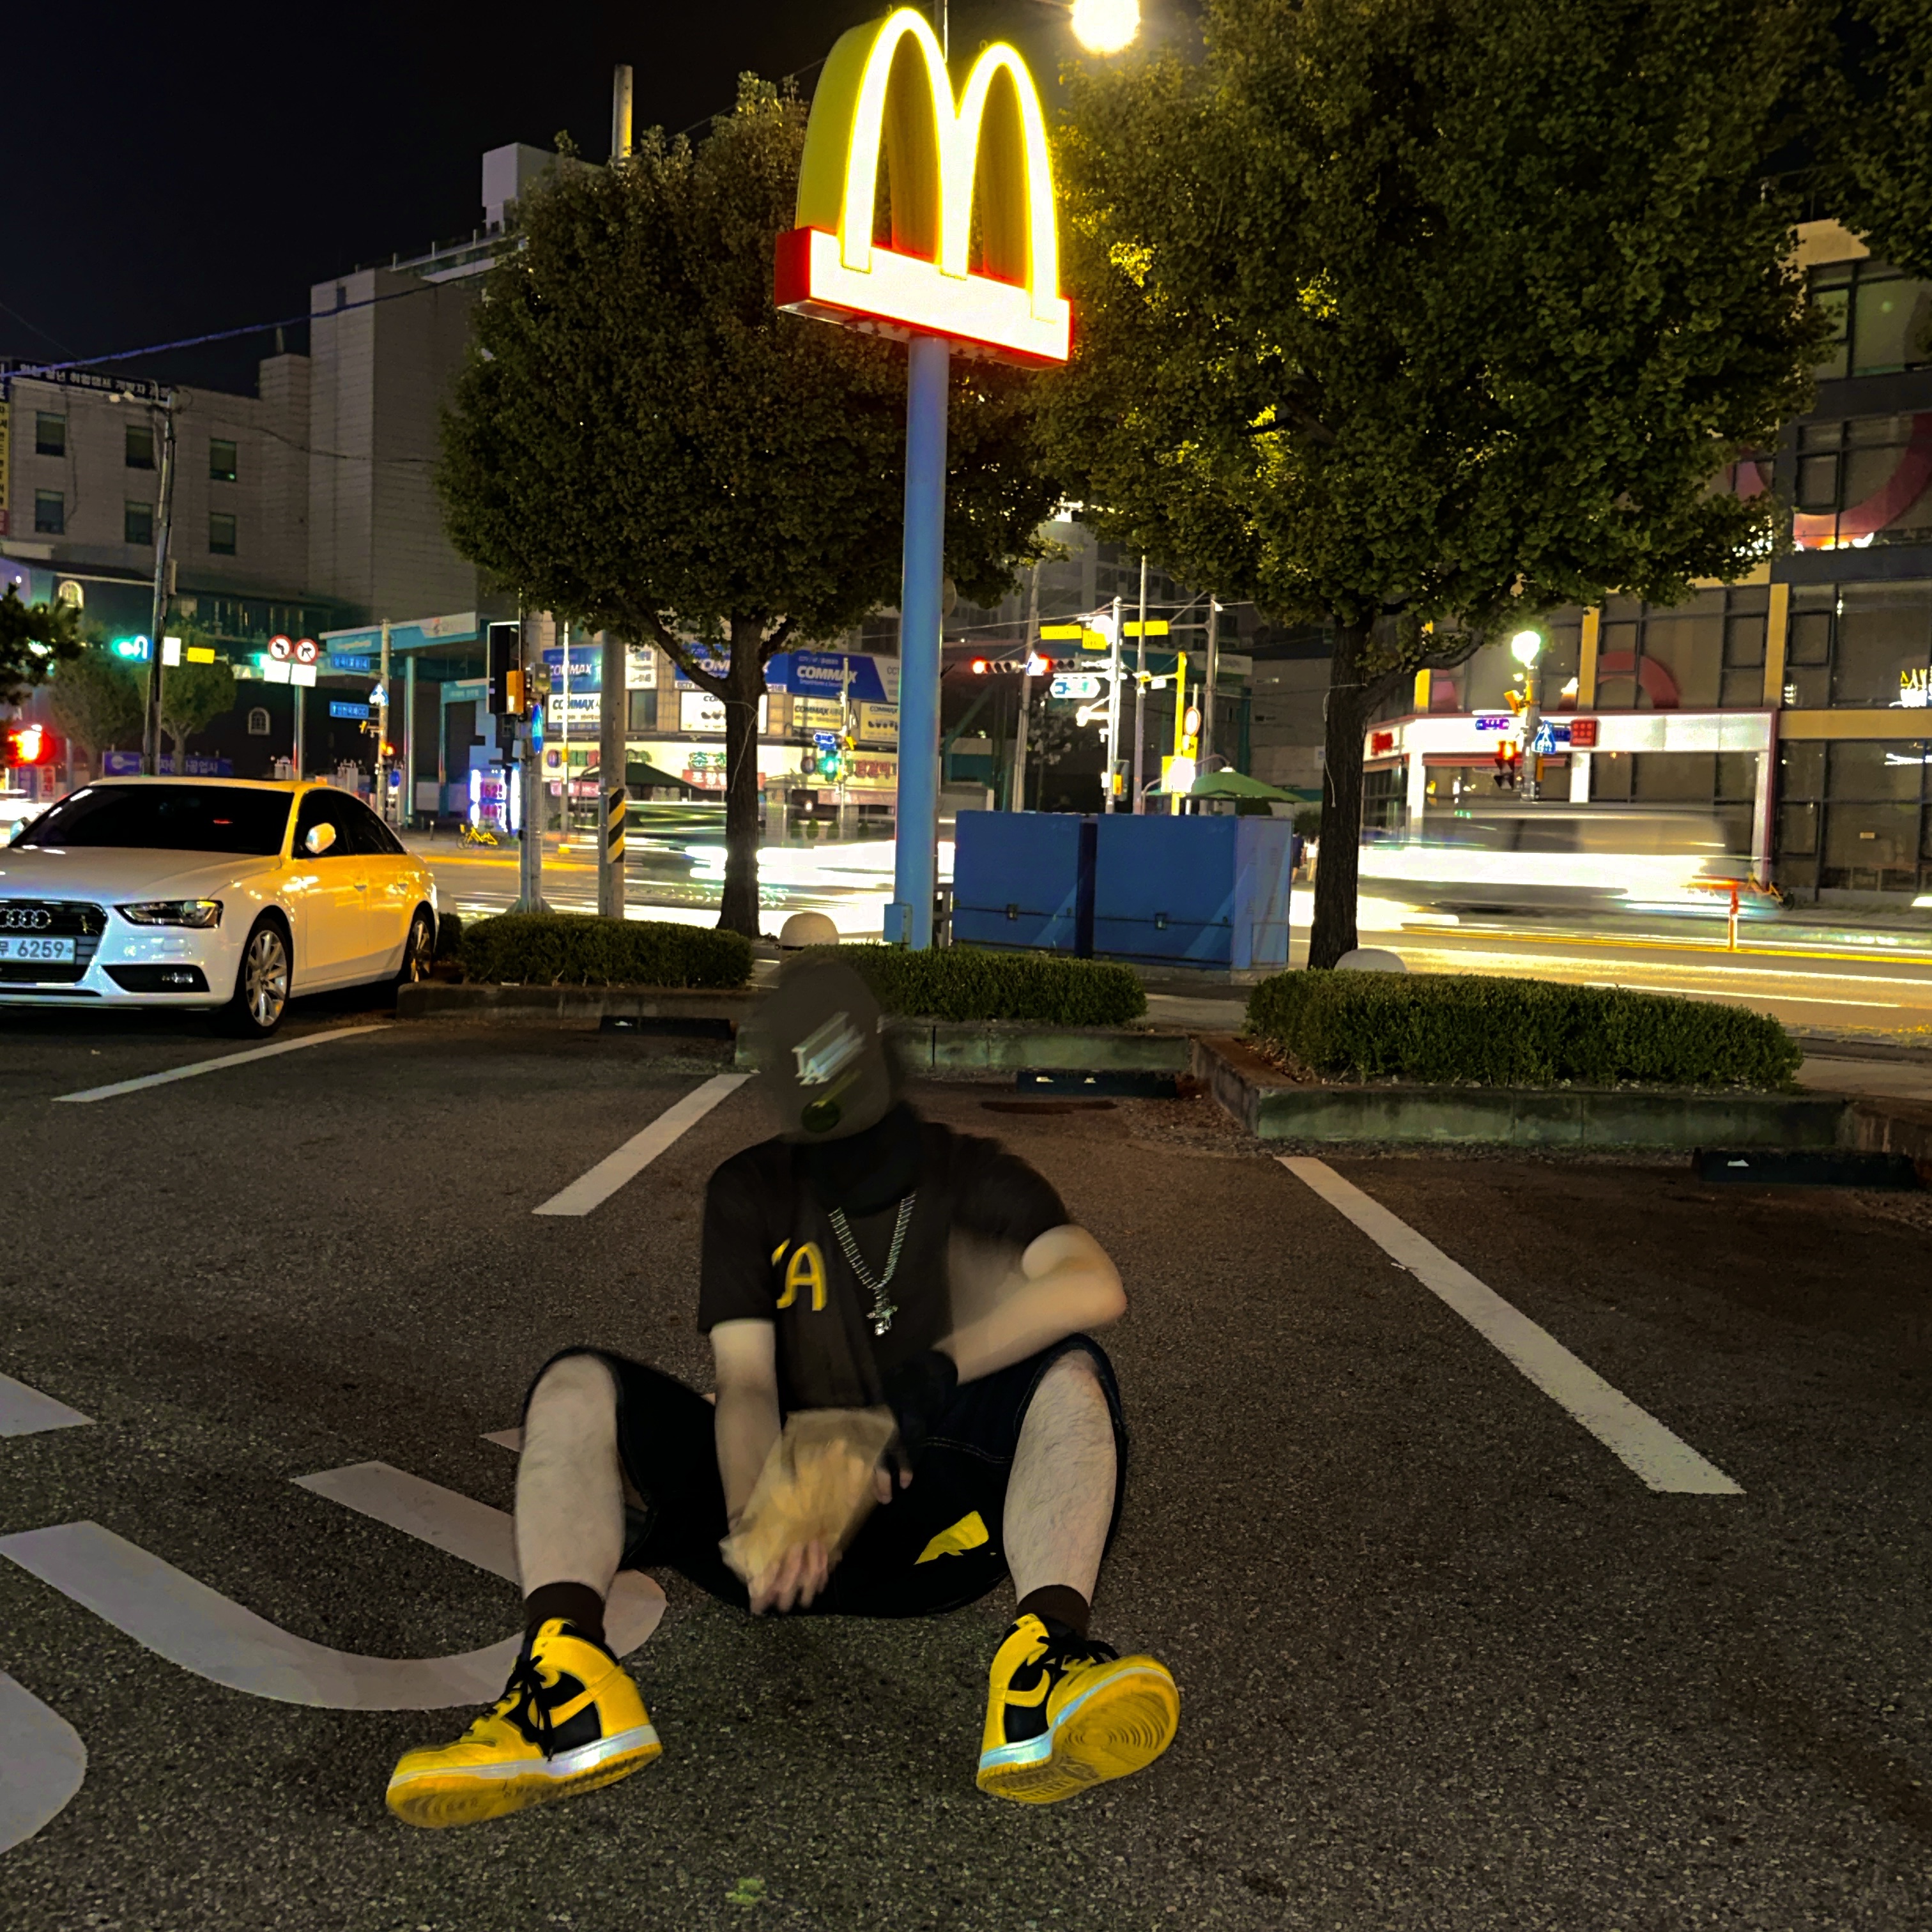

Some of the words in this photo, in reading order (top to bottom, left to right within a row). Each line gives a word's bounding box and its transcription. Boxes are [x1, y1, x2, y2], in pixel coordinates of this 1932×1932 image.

[551, 664, 592, 675] COMAX
[797, 666, 858, 684] COMMAX
[795, 705, 829, 715] COMMAX
[870, 706, 898, 714] COMMAX
[17, 940, 65, 958] 6259
